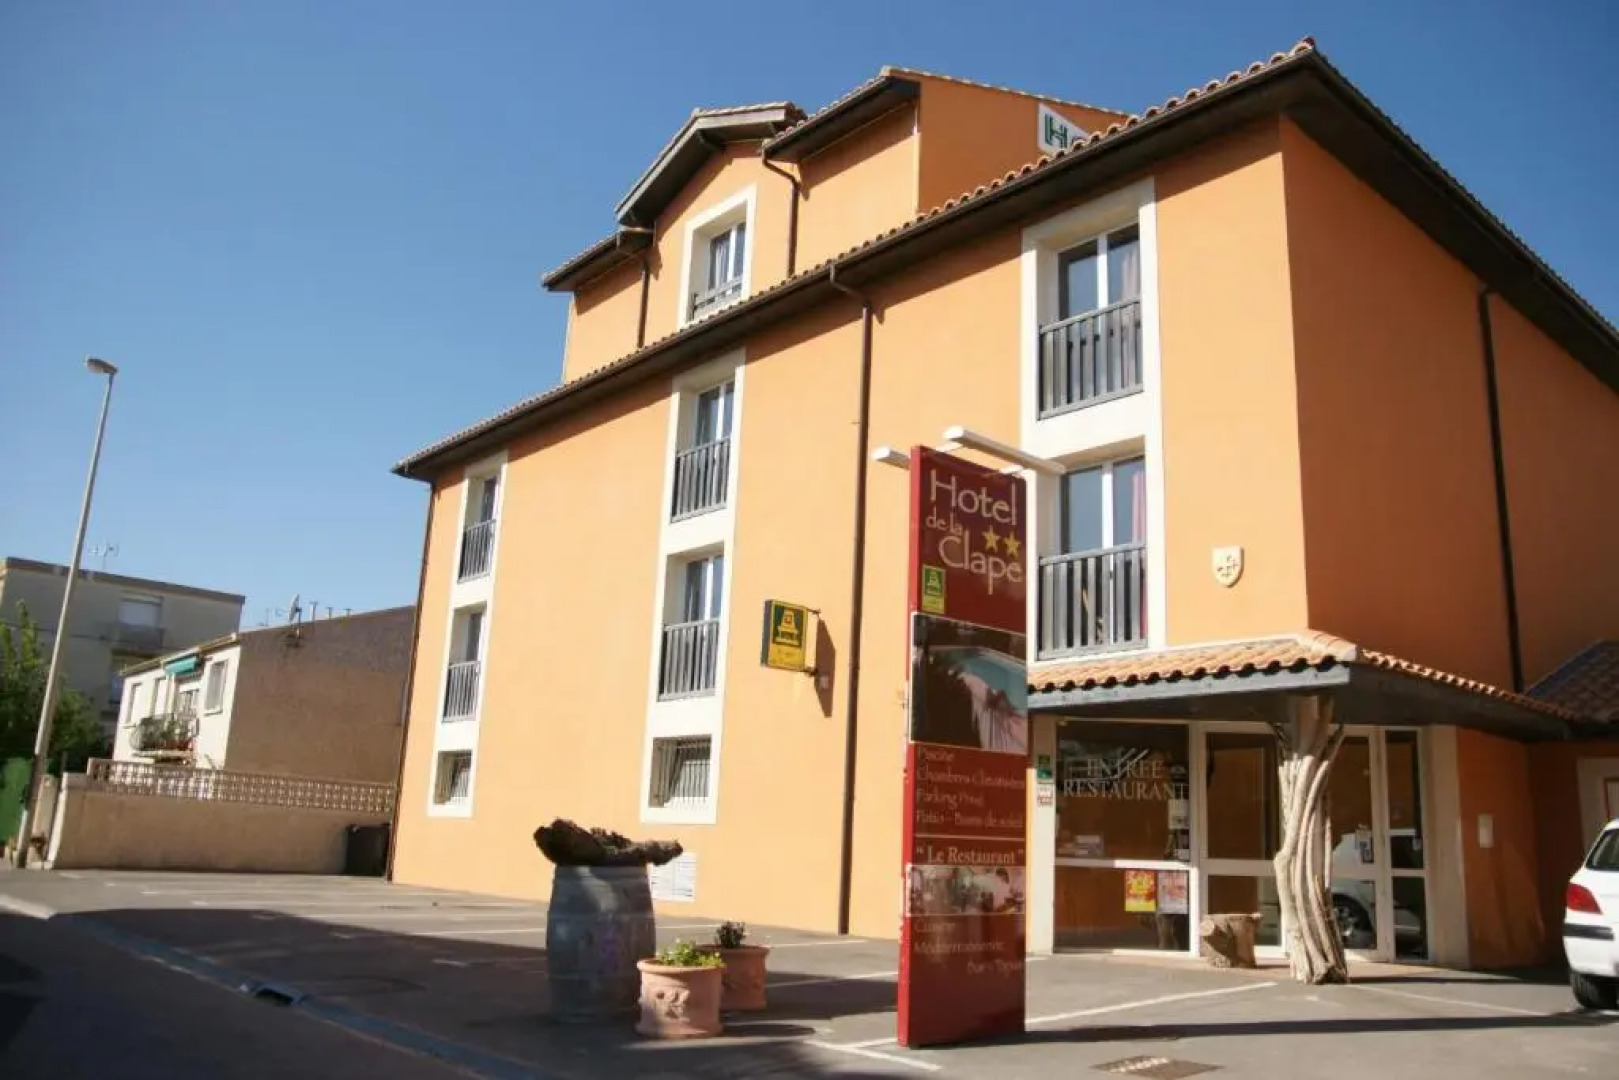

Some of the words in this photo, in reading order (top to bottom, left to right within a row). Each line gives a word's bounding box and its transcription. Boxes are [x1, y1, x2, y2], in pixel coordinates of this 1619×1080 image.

[931, 469, 1017, 526] Hotel
[926, 506, 946, 531] de
[950, 513, 963, 536] la
[938, 529, 1023, 595] Clape
[1063, 778, 1185, 800] RESTAURANT
